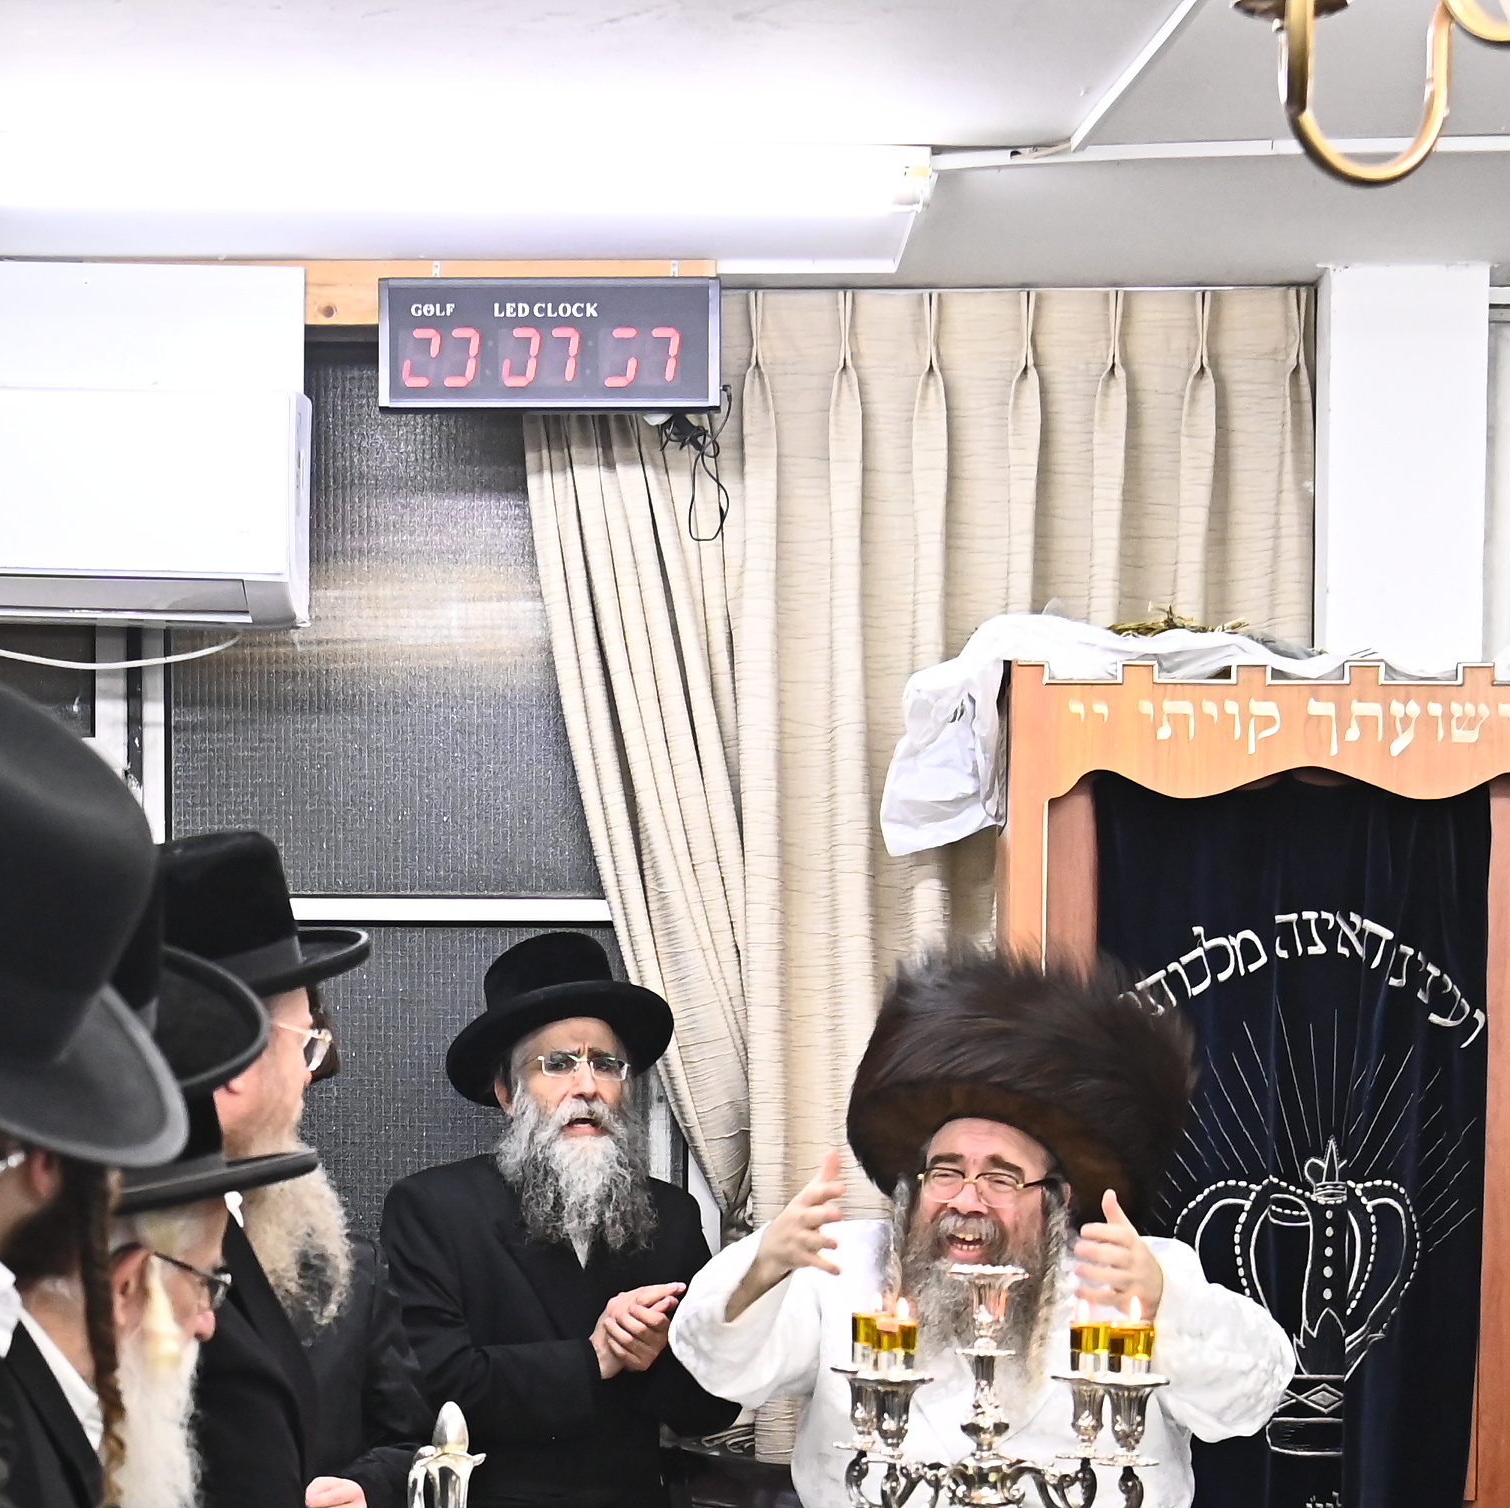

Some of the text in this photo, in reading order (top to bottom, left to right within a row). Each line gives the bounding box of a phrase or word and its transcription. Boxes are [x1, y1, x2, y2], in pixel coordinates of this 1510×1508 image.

[410, 302, 598, 318] GOLF LED CLOCK
[1068, 698, 1110, 724] יי
[1138, 698, 1281, 755] קויתי
